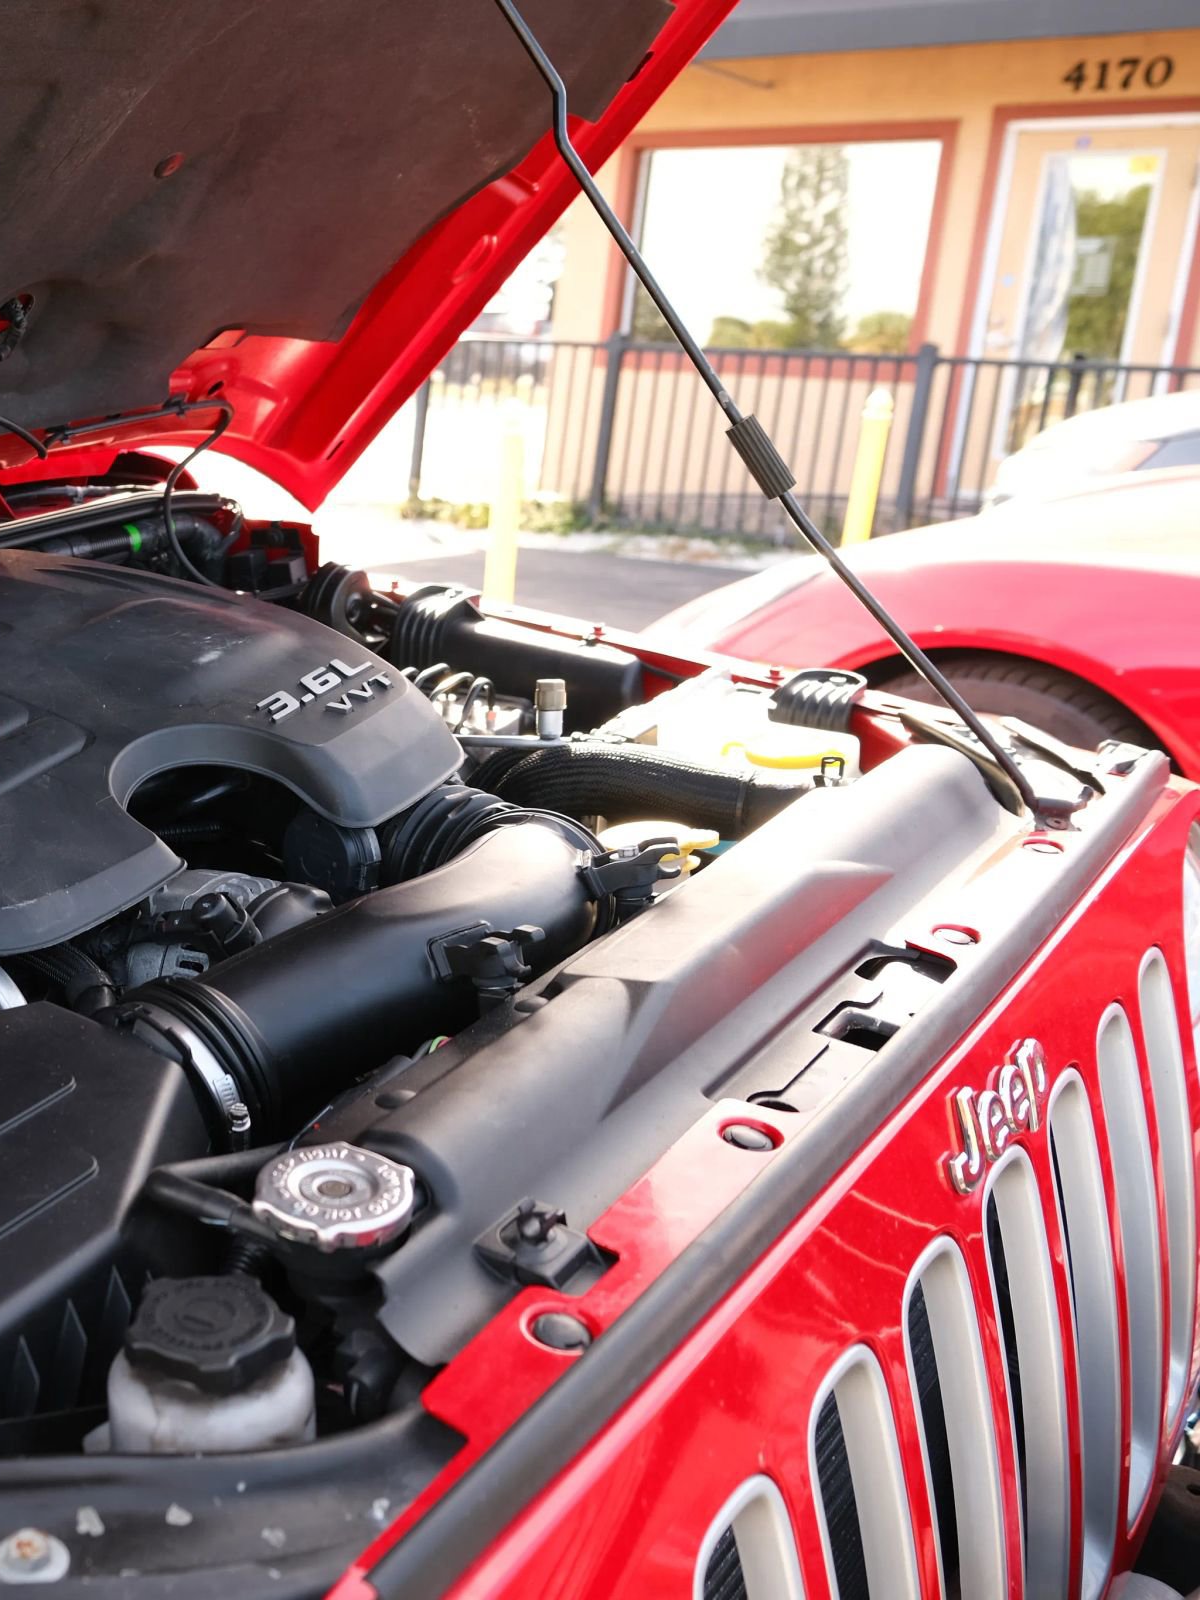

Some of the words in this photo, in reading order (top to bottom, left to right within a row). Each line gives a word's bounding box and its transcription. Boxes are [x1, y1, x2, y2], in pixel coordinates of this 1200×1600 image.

[1062, 55, 1175, 92] 4170
[255, 658, 374, 725] 3.6L
[324, 671, 393, 716] VVT
[944, 1037, 1049, 1195] Jeep
